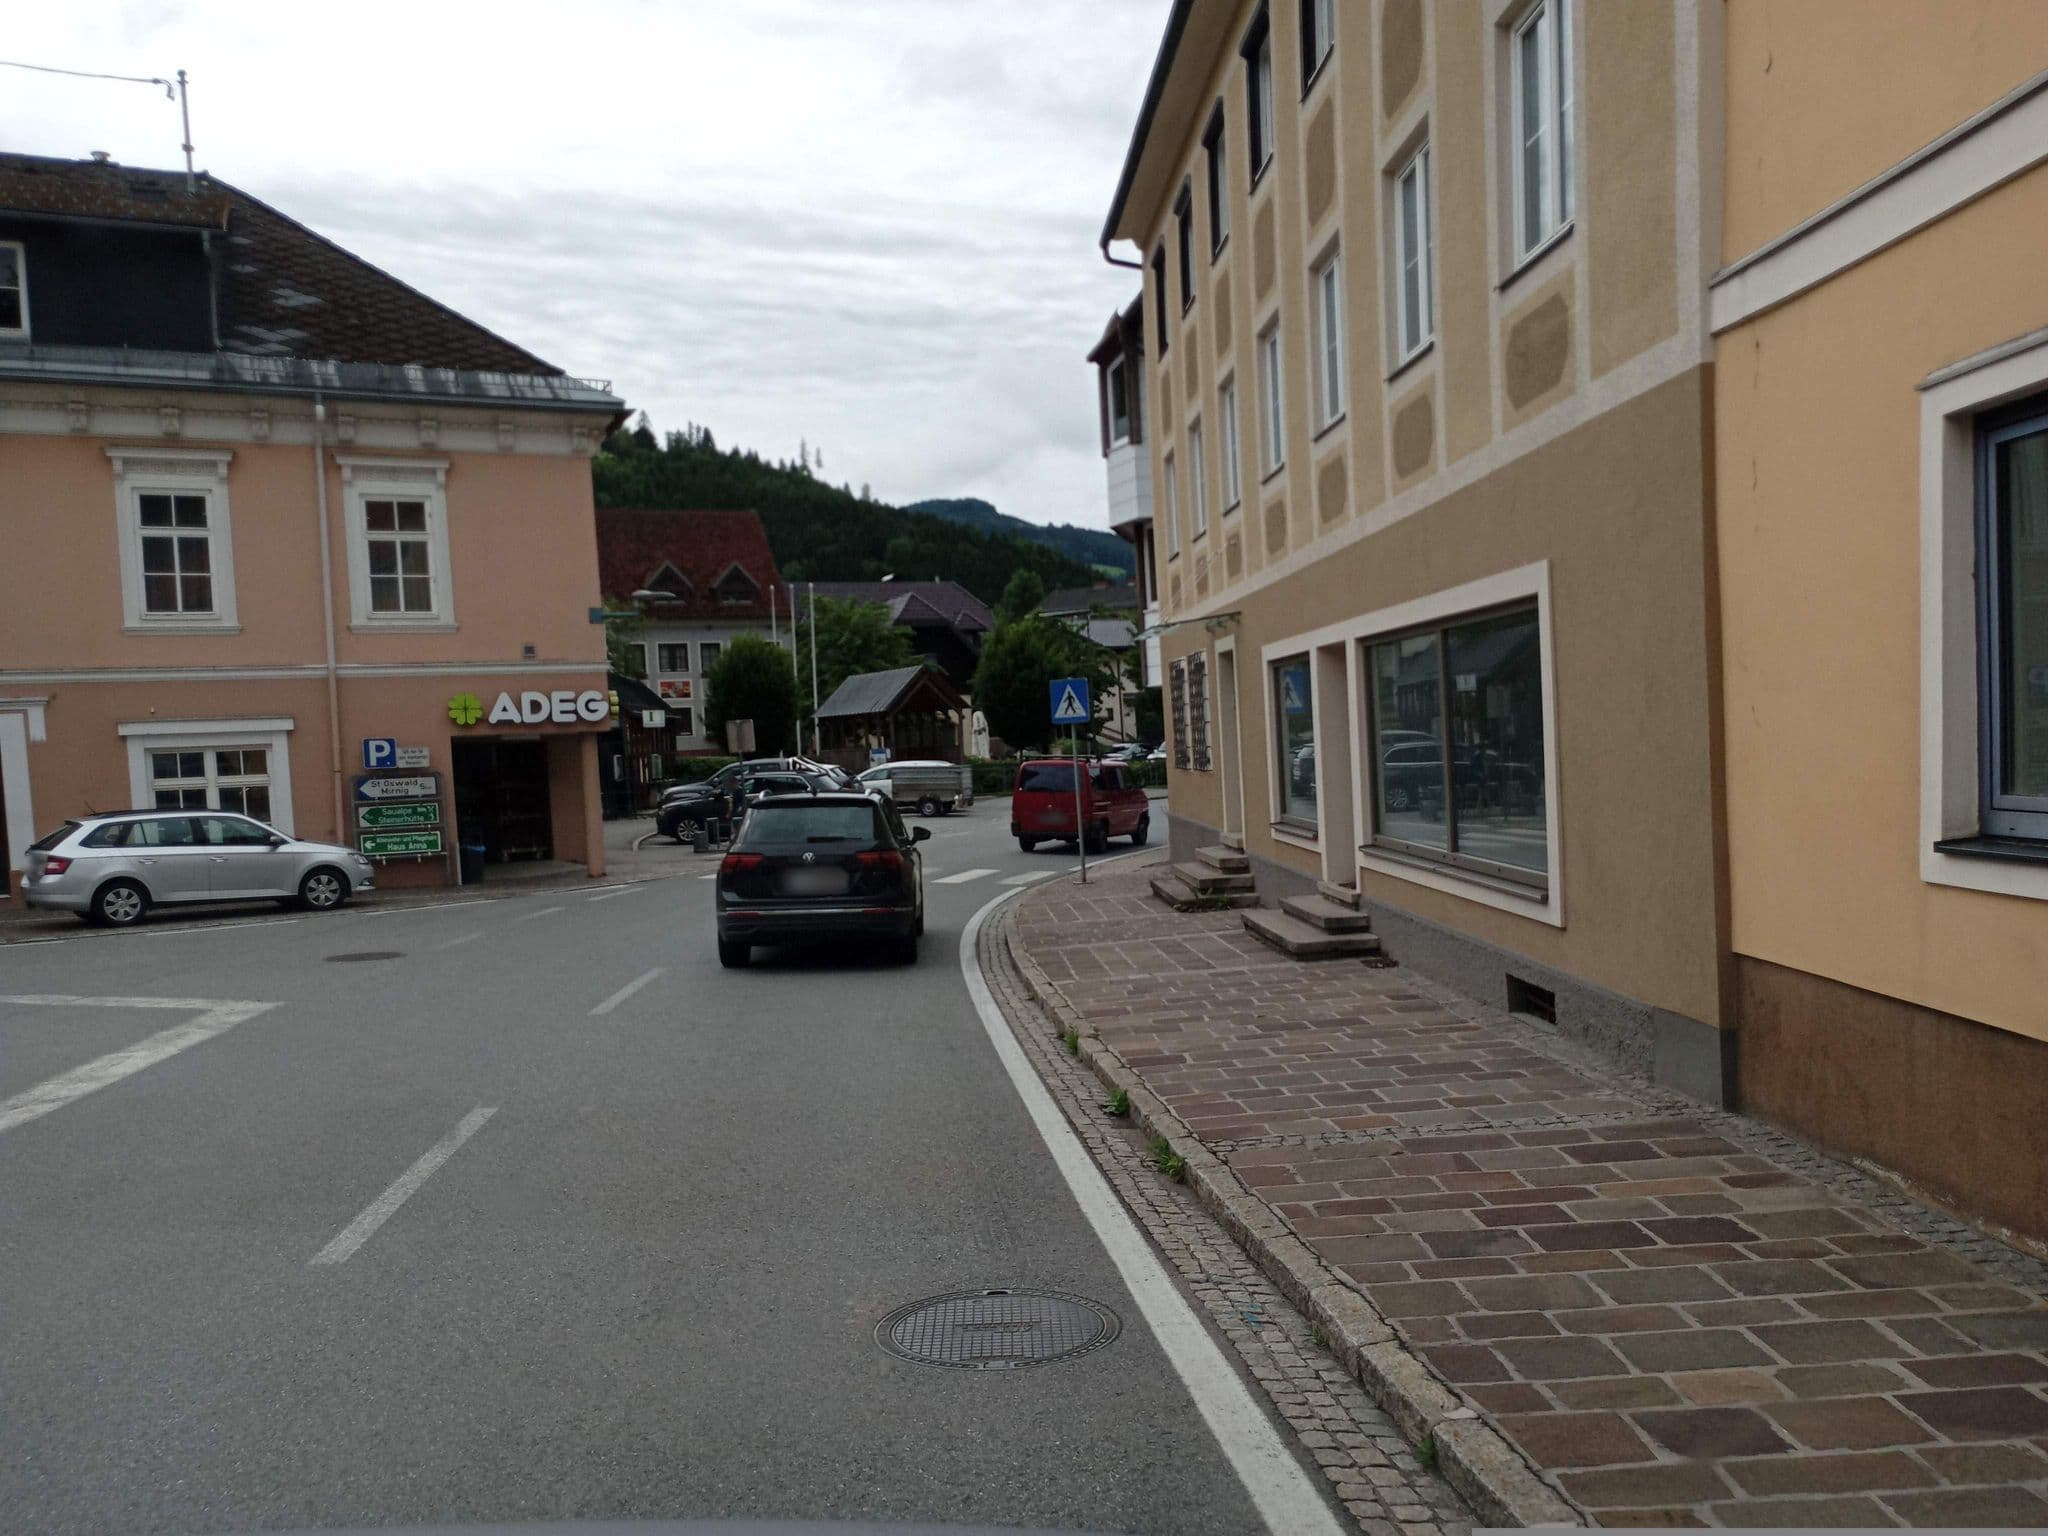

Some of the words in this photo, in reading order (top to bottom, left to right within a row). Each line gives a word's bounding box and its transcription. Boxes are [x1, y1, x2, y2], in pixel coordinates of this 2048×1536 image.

[488, 690, 609, 724] ADEG
[369, 740, 391, 767] P
[384, 779, 418, 787] Oswald
[387, 843, 406, 851] Haus
[408, 841, 427, 850] Anna
